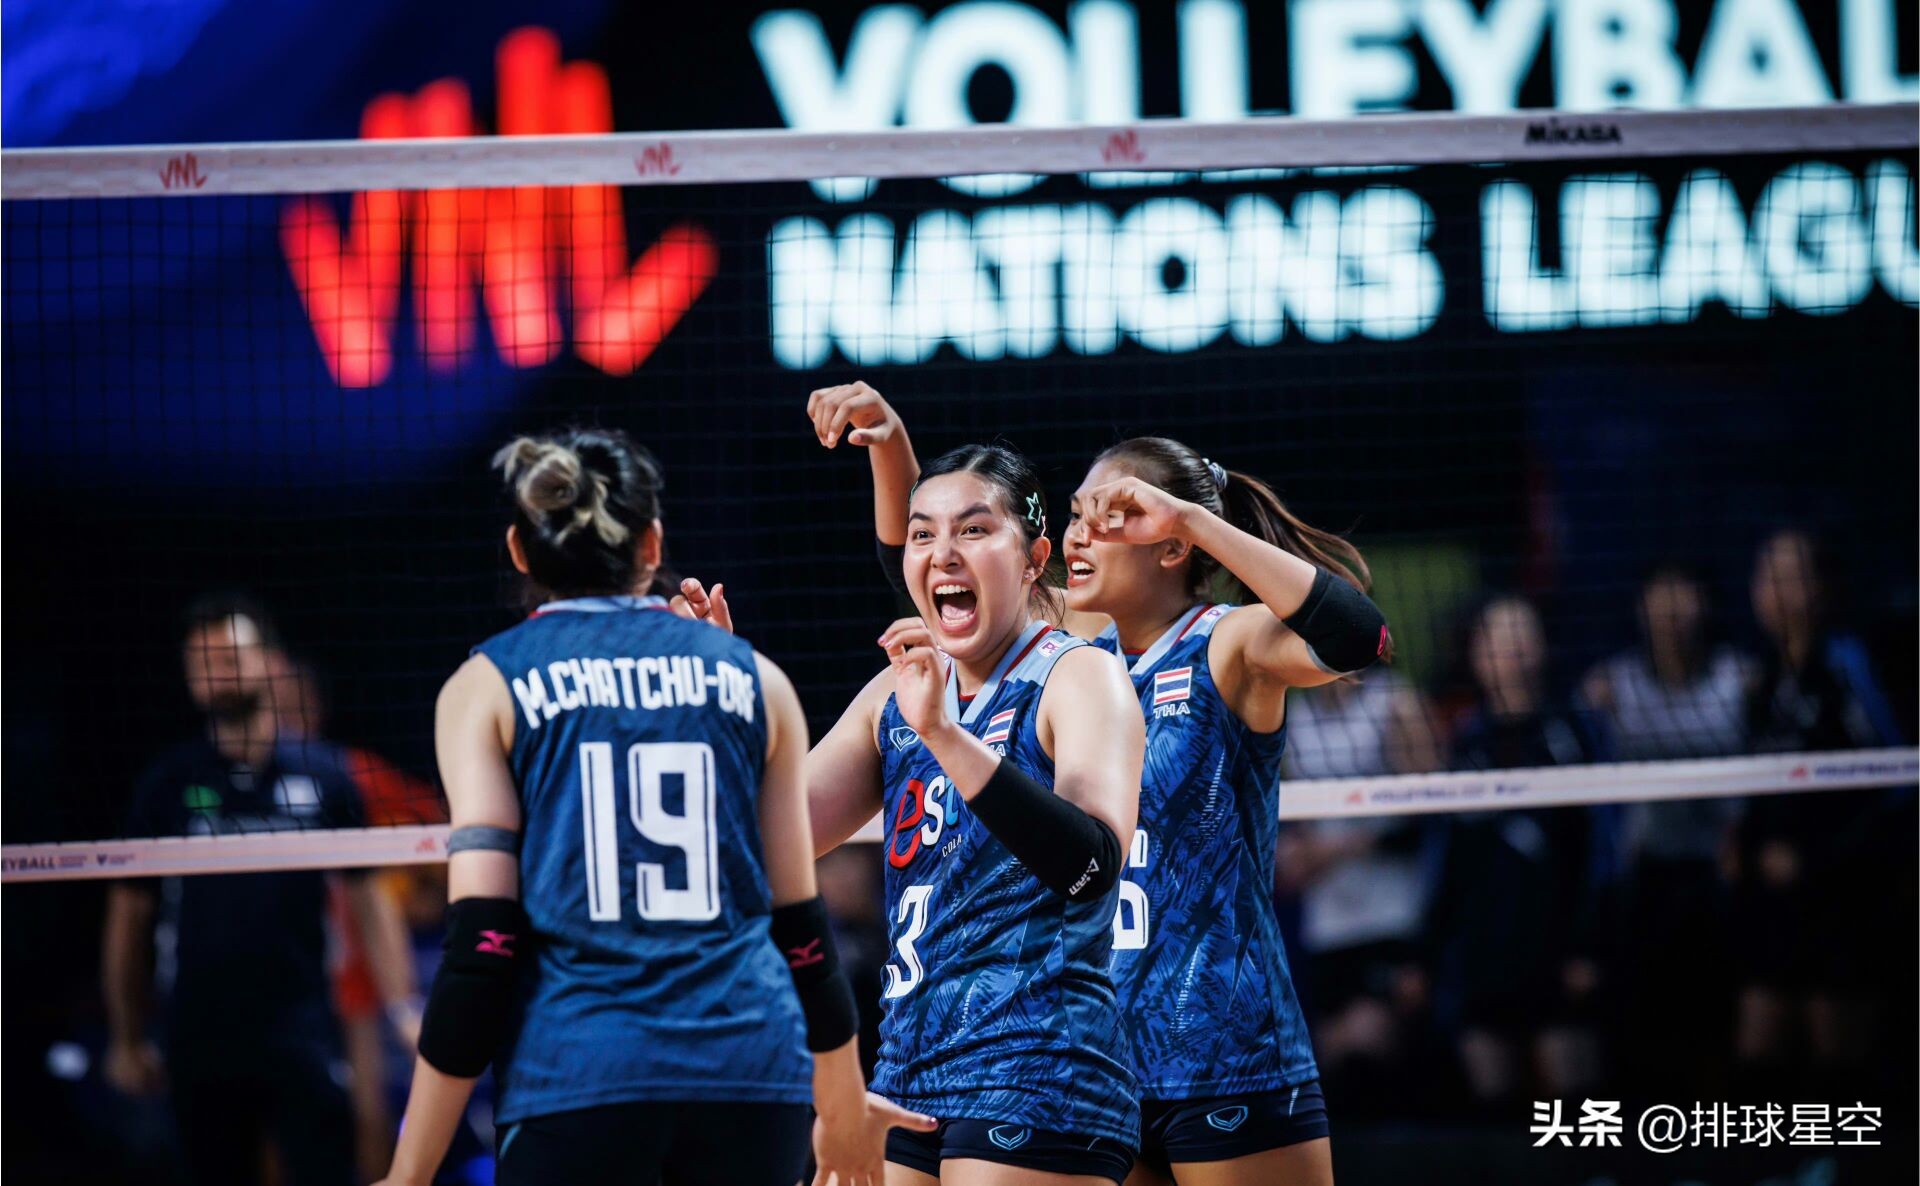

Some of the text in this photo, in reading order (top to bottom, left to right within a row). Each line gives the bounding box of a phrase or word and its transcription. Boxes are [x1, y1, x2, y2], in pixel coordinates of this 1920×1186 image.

[159, 152, 208, 190] VNL
[766, 187, 1443, 370] NATIONS
[512, 655, 755, 729] M.CHATCHU-ON
[1153, 702, 1190, 719] THA
[579, 741, 721, 921] 19
[941, 833, 962, 858] COLA
[884, 885, 934, 999] 3
